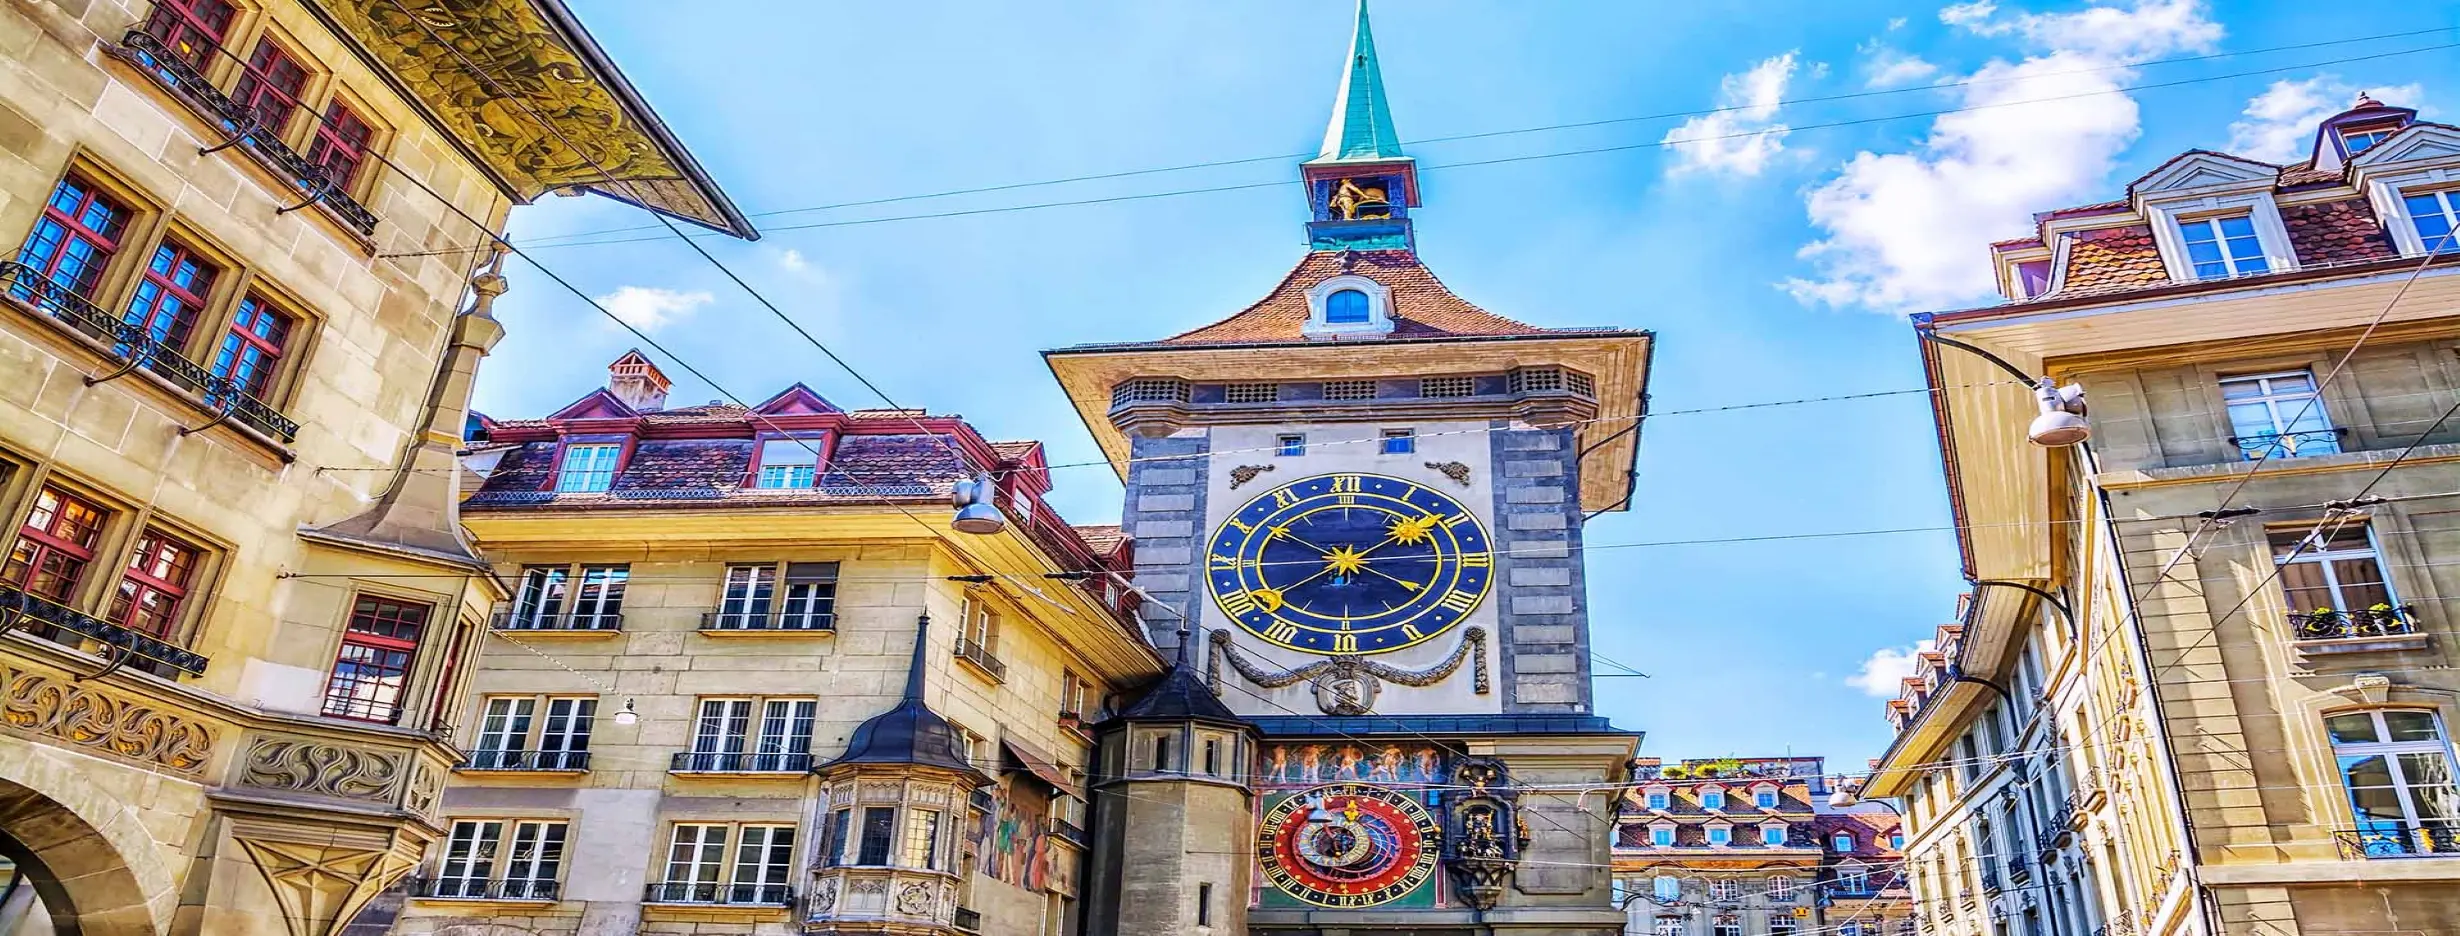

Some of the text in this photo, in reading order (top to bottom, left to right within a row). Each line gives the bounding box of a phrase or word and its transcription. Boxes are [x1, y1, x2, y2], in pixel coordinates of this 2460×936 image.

[1330, 476, 1362, 493] XII
[1443, 511, 1470, 529] II
[1462, 552, 1489, 567] III
